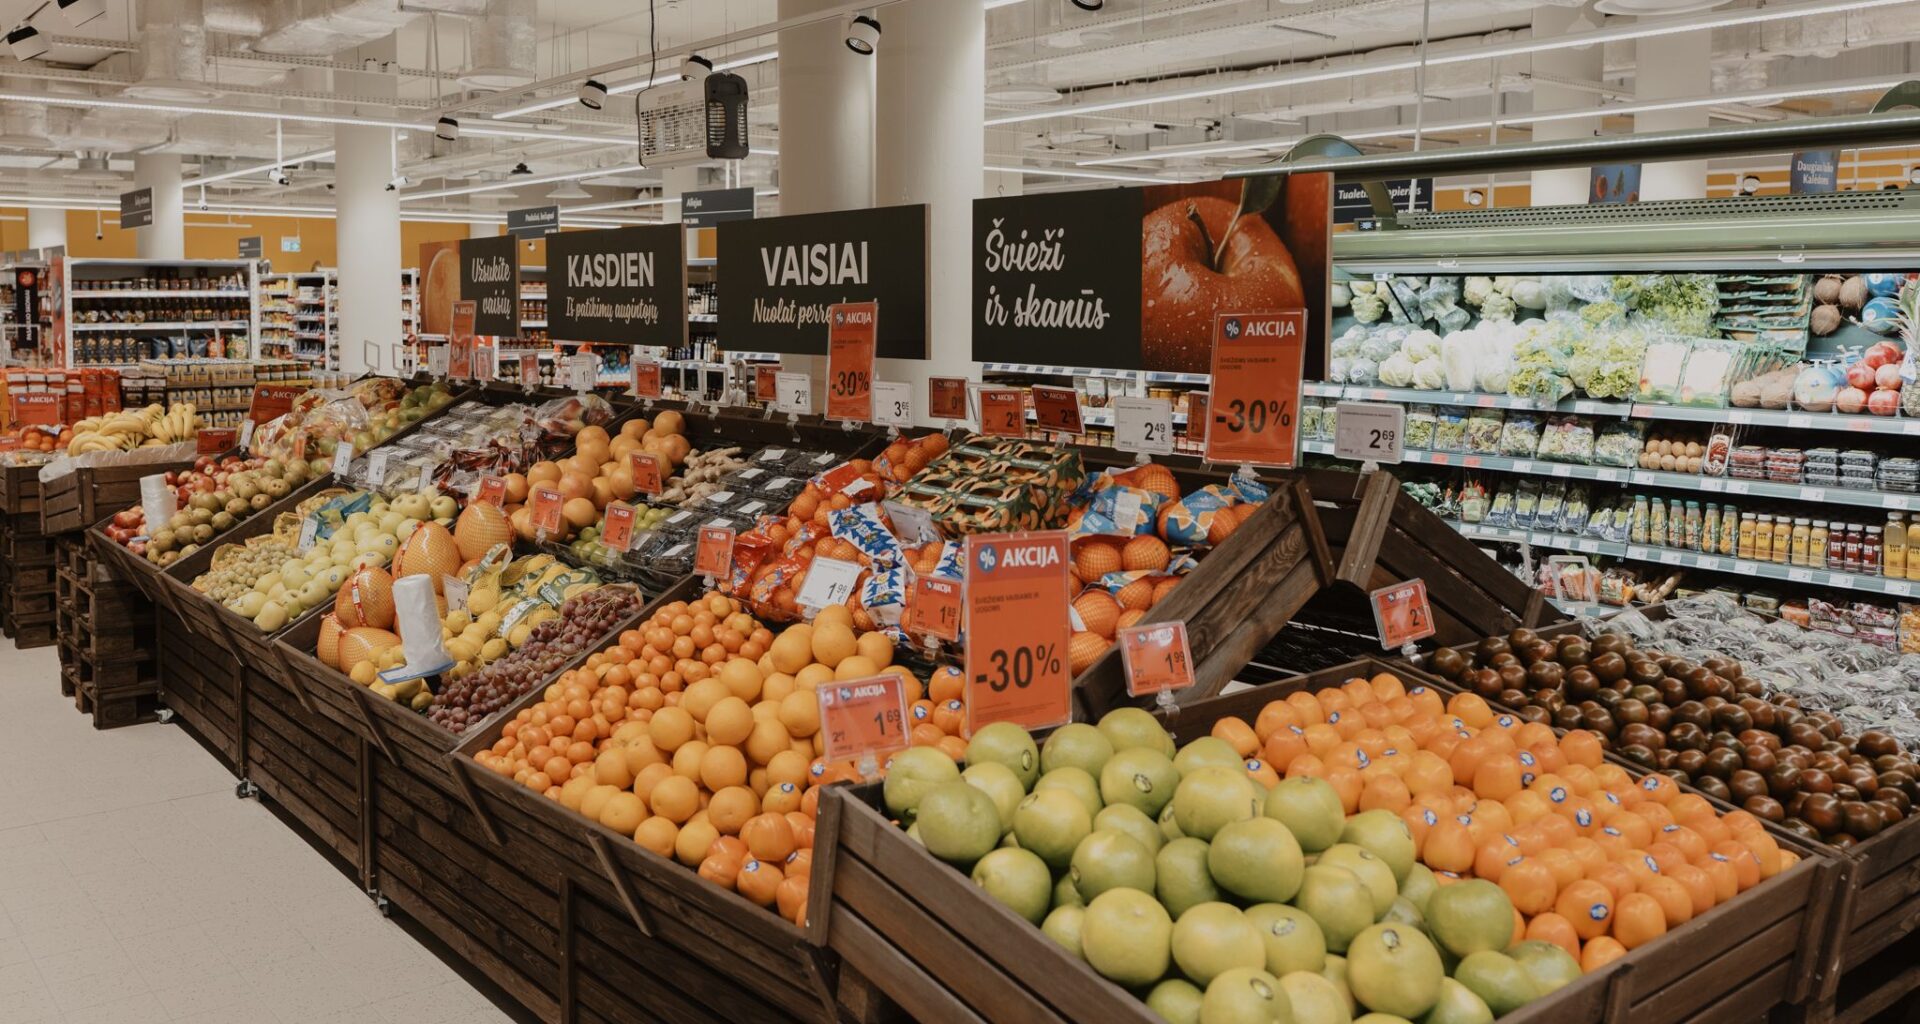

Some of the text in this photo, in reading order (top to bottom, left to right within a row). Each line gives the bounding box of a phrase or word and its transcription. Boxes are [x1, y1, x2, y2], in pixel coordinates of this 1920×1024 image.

[985, 217, 1065, 273] Švieži
[471, 255, 511, 283] Užsukite
[567, 251, 655, 288] KASDIEN
[760, 241, 868, 287] VAISIAI
[482, 290, 511, 320] vaisių
[566, 296, 659, 325] Iš patikimų augintojų
[753, 297, 797, 324] Nuolat
[846, 311, 872, 324] AKCIJA
[985, 283, 1110, 330] ir skanūs
[1245, 320, 1296, 338] AKCIJA
[832, 371, 870, 396] -30%
[29, 395, 55, 403] AKCIJA
[1215, 399, 1291, 434] -30%
[1001, 545, 1060, 569] AKCIJA
[975, 643, 1060, 692] -30%
[854, 684, 886, 698] AKCIJA
